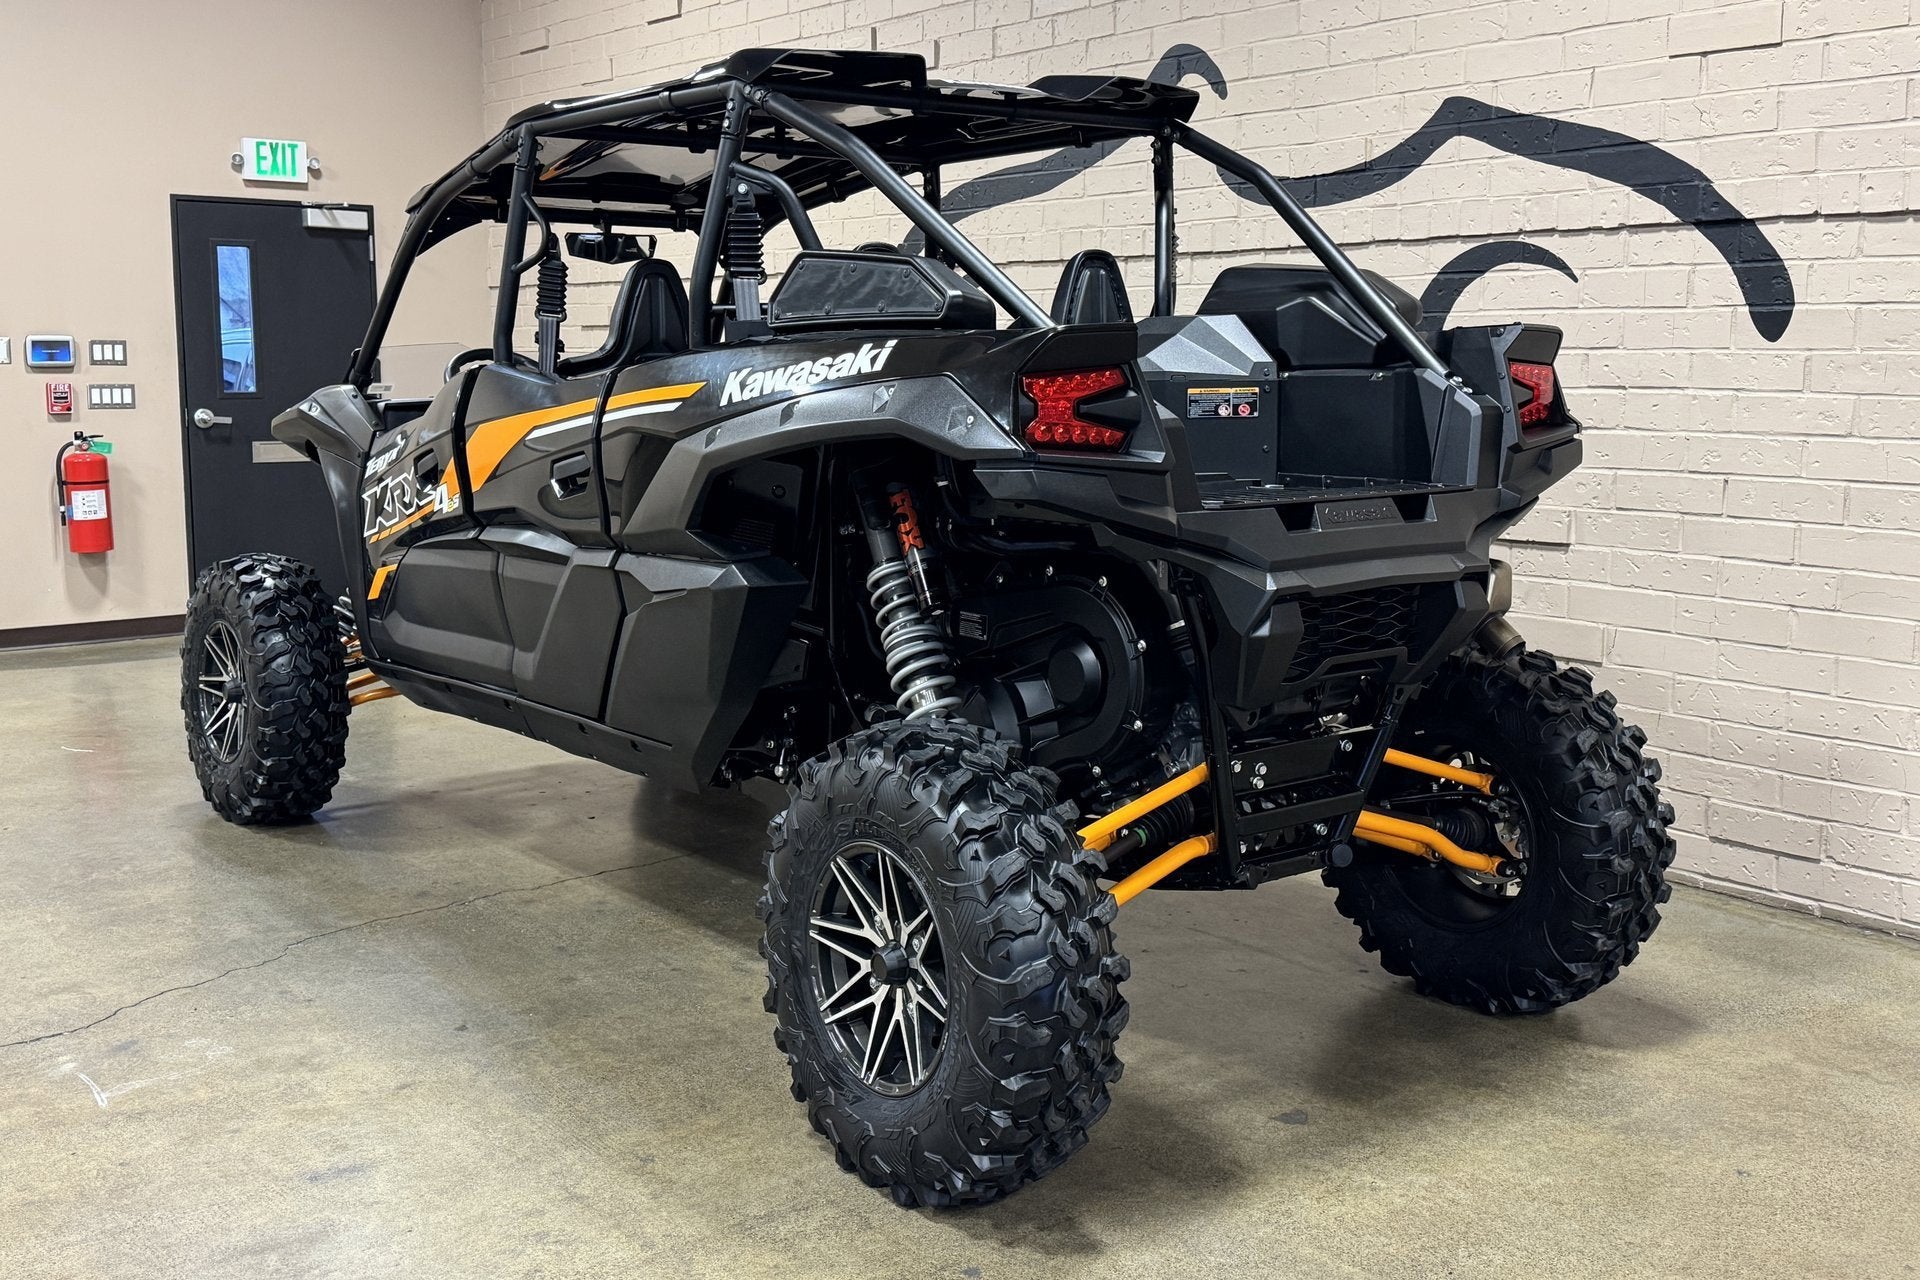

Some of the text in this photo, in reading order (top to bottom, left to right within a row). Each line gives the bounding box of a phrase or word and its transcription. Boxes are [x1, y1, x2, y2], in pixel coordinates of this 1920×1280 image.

[255, 141, 299, 177] EXIT
[51, 383, 70, 392] FIRE
[719, 339, 899, 407] Kawasaki
[889, 489, 925, 557] FOX
